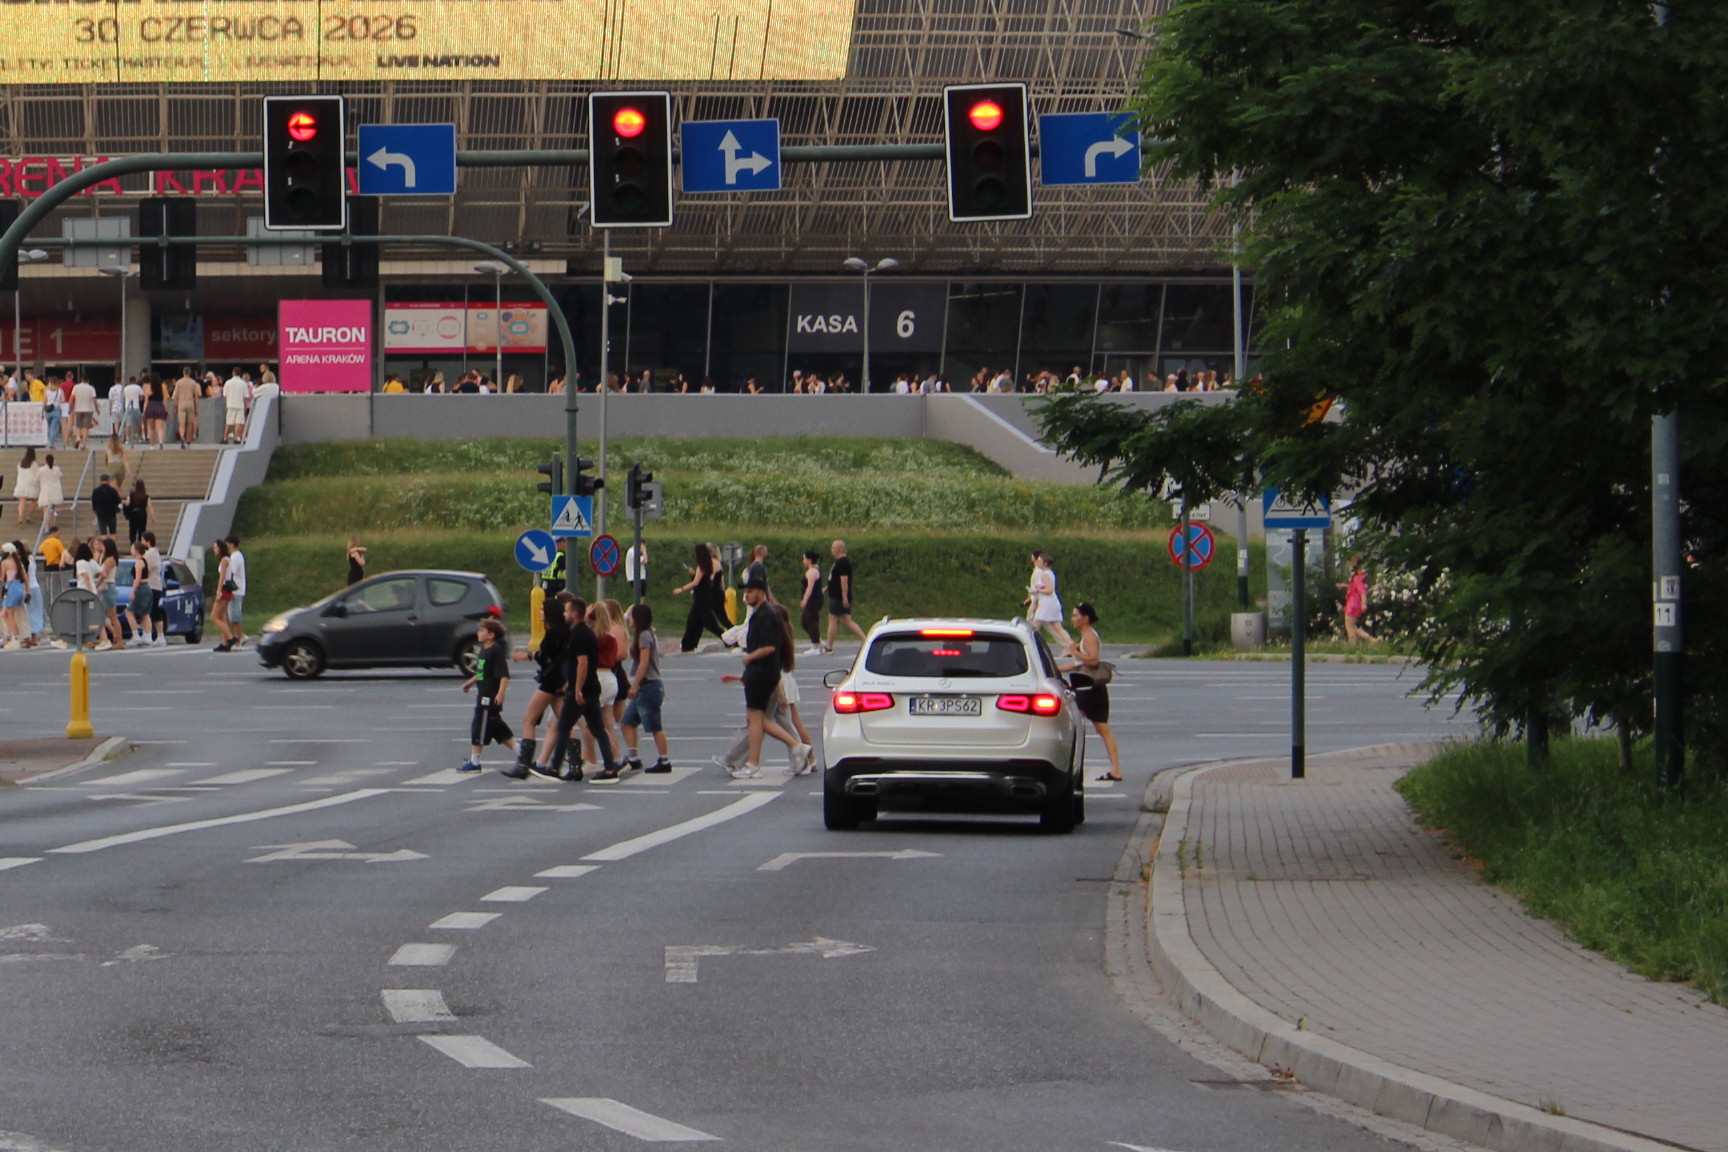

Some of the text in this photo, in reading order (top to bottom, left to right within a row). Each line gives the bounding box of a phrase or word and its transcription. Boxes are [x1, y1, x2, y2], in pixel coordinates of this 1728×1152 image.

[75, 15, 417, 43] 30 CZERWCA 2026
[377, 55, 421, 67] LIVE
[423, 55, 500, 67] NATION
[797, 310, 915, 338] KASA 6
[50, 328, 63, 355] 1
[211, 328, 276, 345] sektory
[285, 327, 365, 343] TAURON
[285, 353, 365, 364] ARENA KRAKÓW
[917, 699, 977, 712] KR 3PS62
